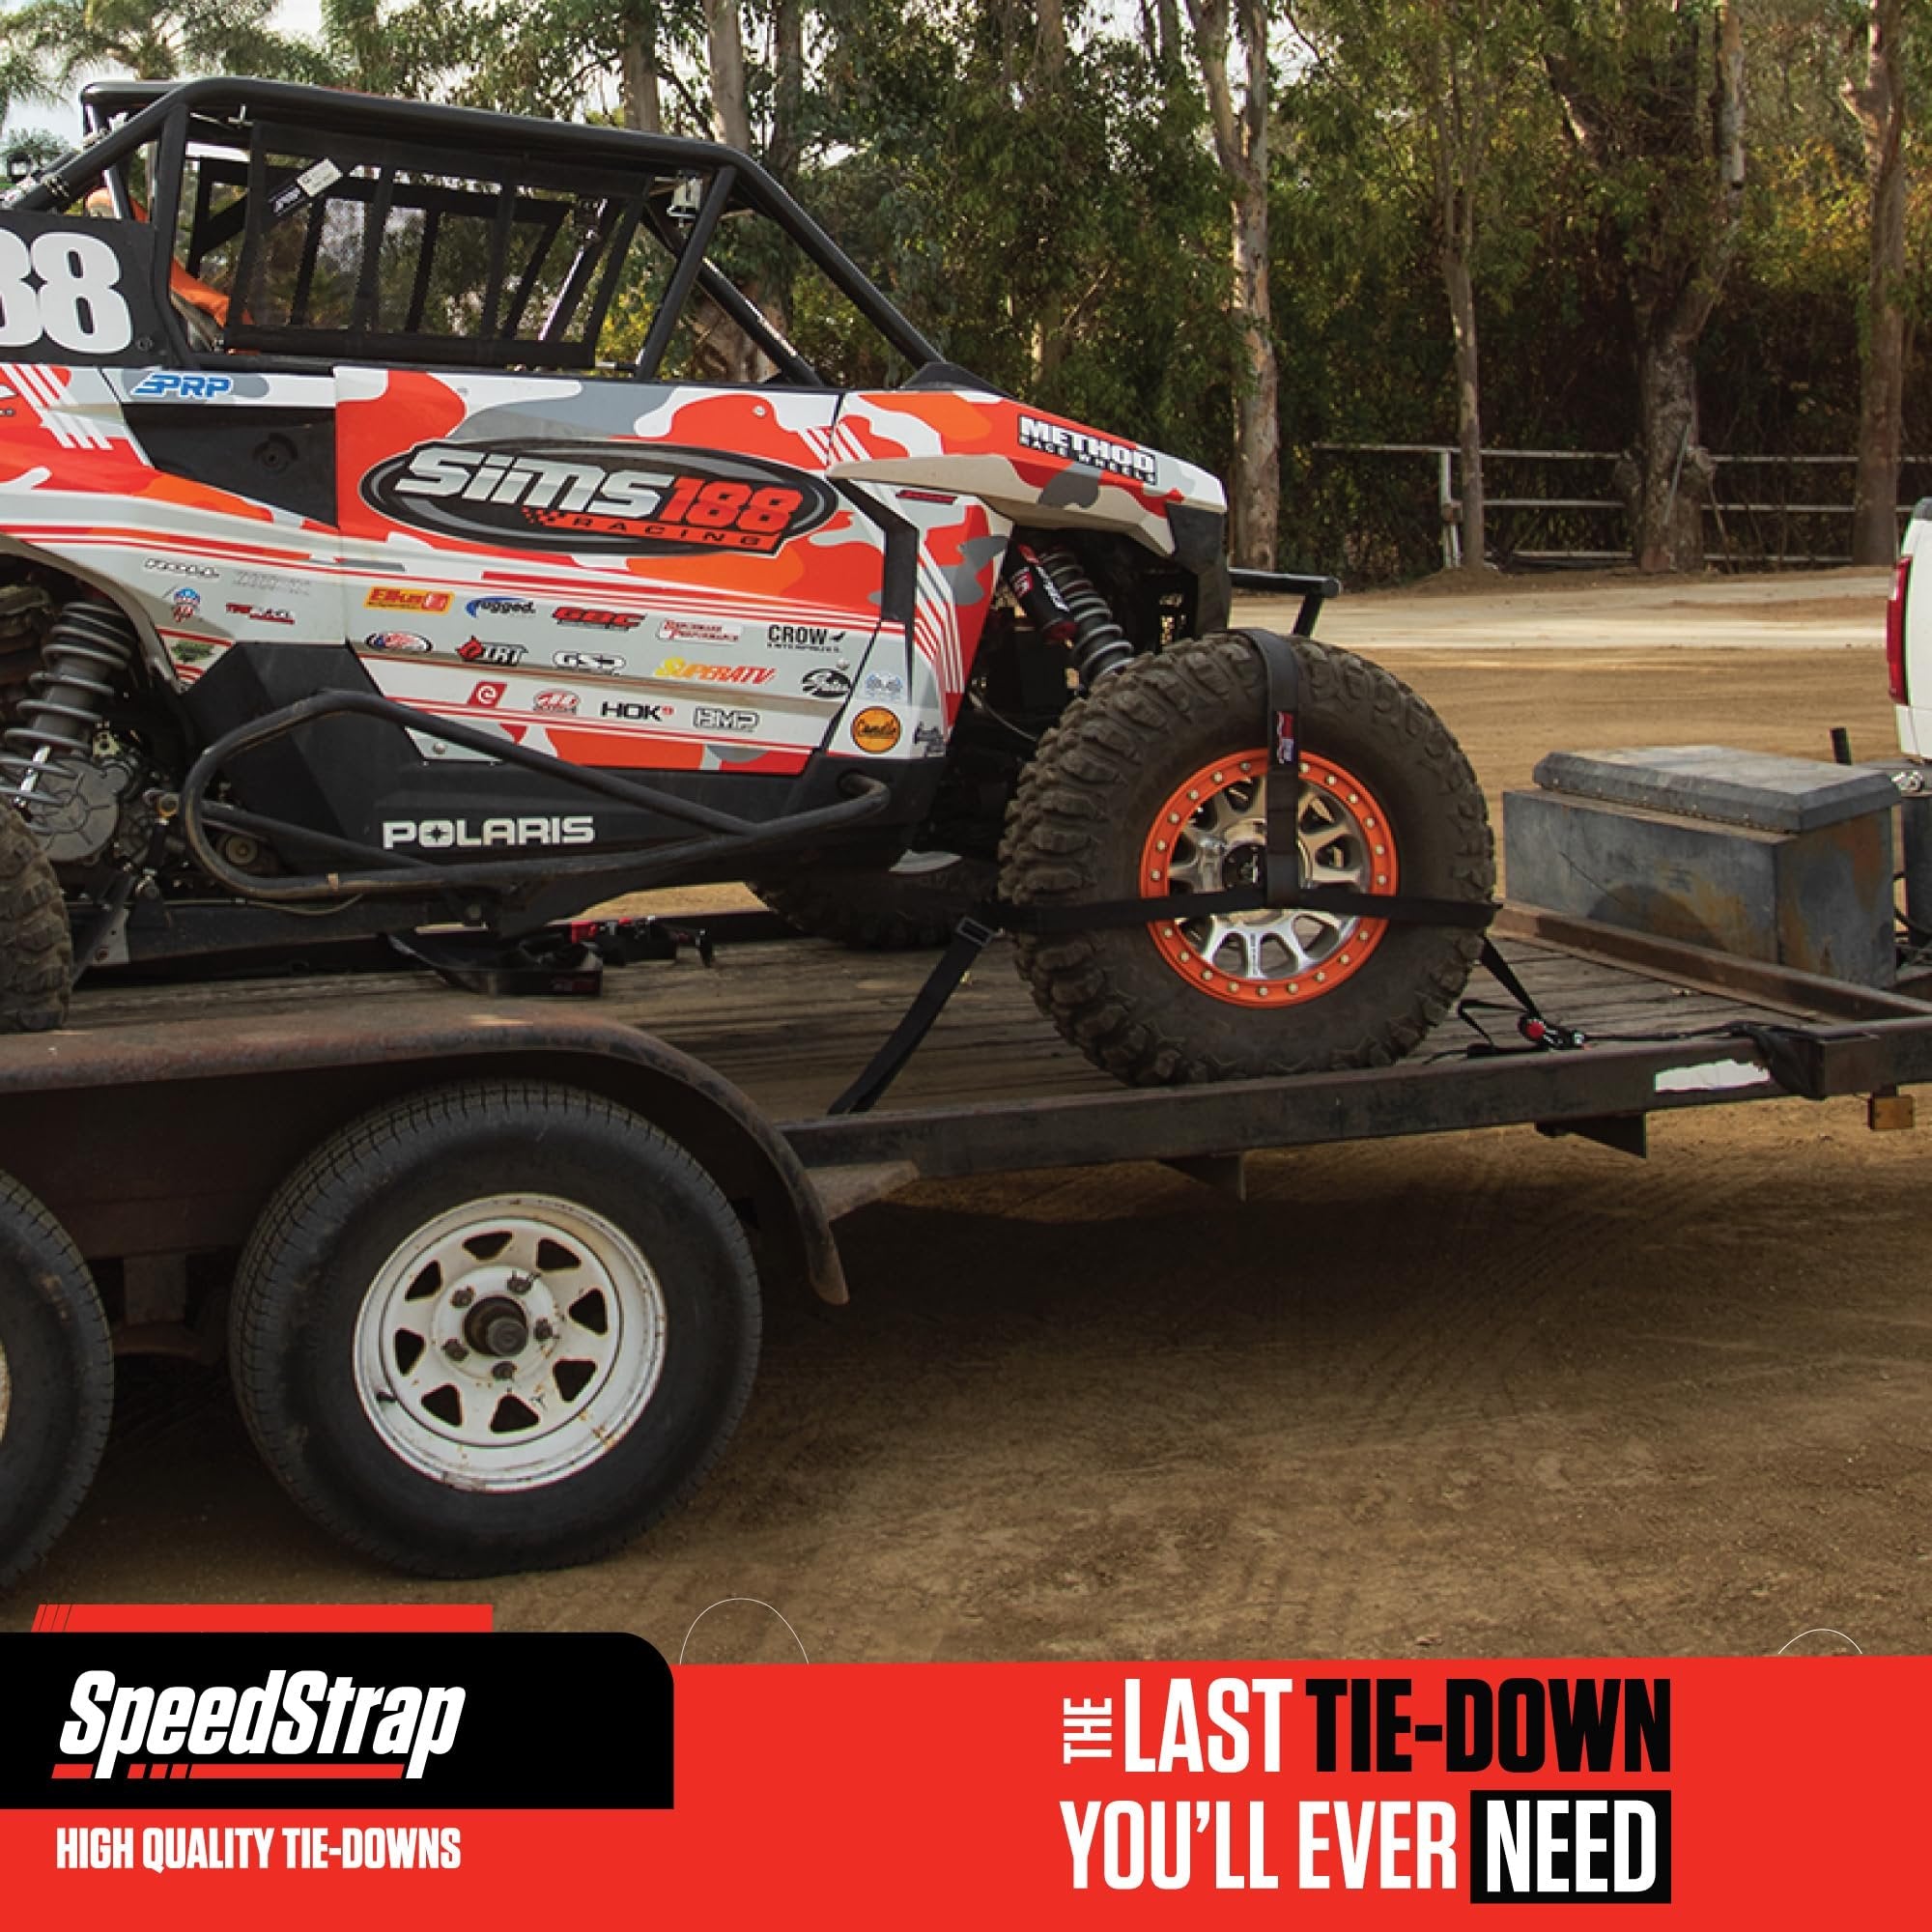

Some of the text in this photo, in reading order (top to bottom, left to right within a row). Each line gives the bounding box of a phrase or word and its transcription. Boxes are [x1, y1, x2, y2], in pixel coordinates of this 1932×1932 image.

[133, 373, 233, 398] PRP
[1020, 416, 1155, 472] METHOD
[573, 517, 762, 546] RACING
[768, 624, 827, 645] CROW
[383, 816, 595, 850] POLARIS
